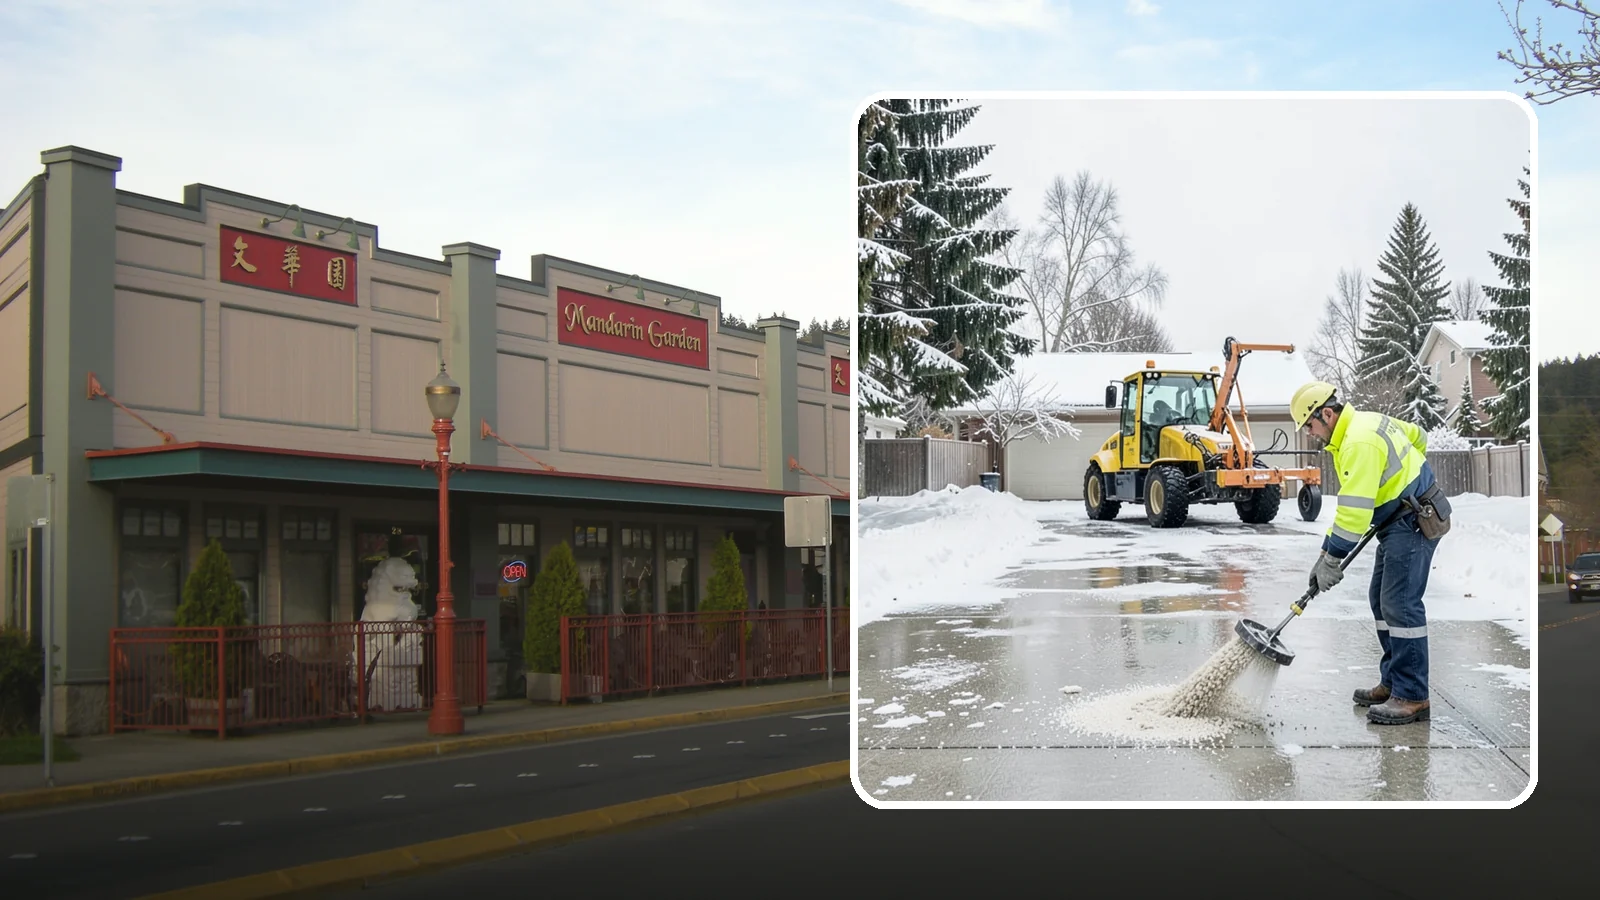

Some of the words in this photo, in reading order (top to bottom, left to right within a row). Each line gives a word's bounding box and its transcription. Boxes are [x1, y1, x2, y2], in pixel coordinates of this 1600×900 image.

[231, 235, 346, 290] 文華園
[564, 302, 644, 341] Mandarin
[648, 320, 702, 352] Garden
[503, 565, 527, 578] OPEN
